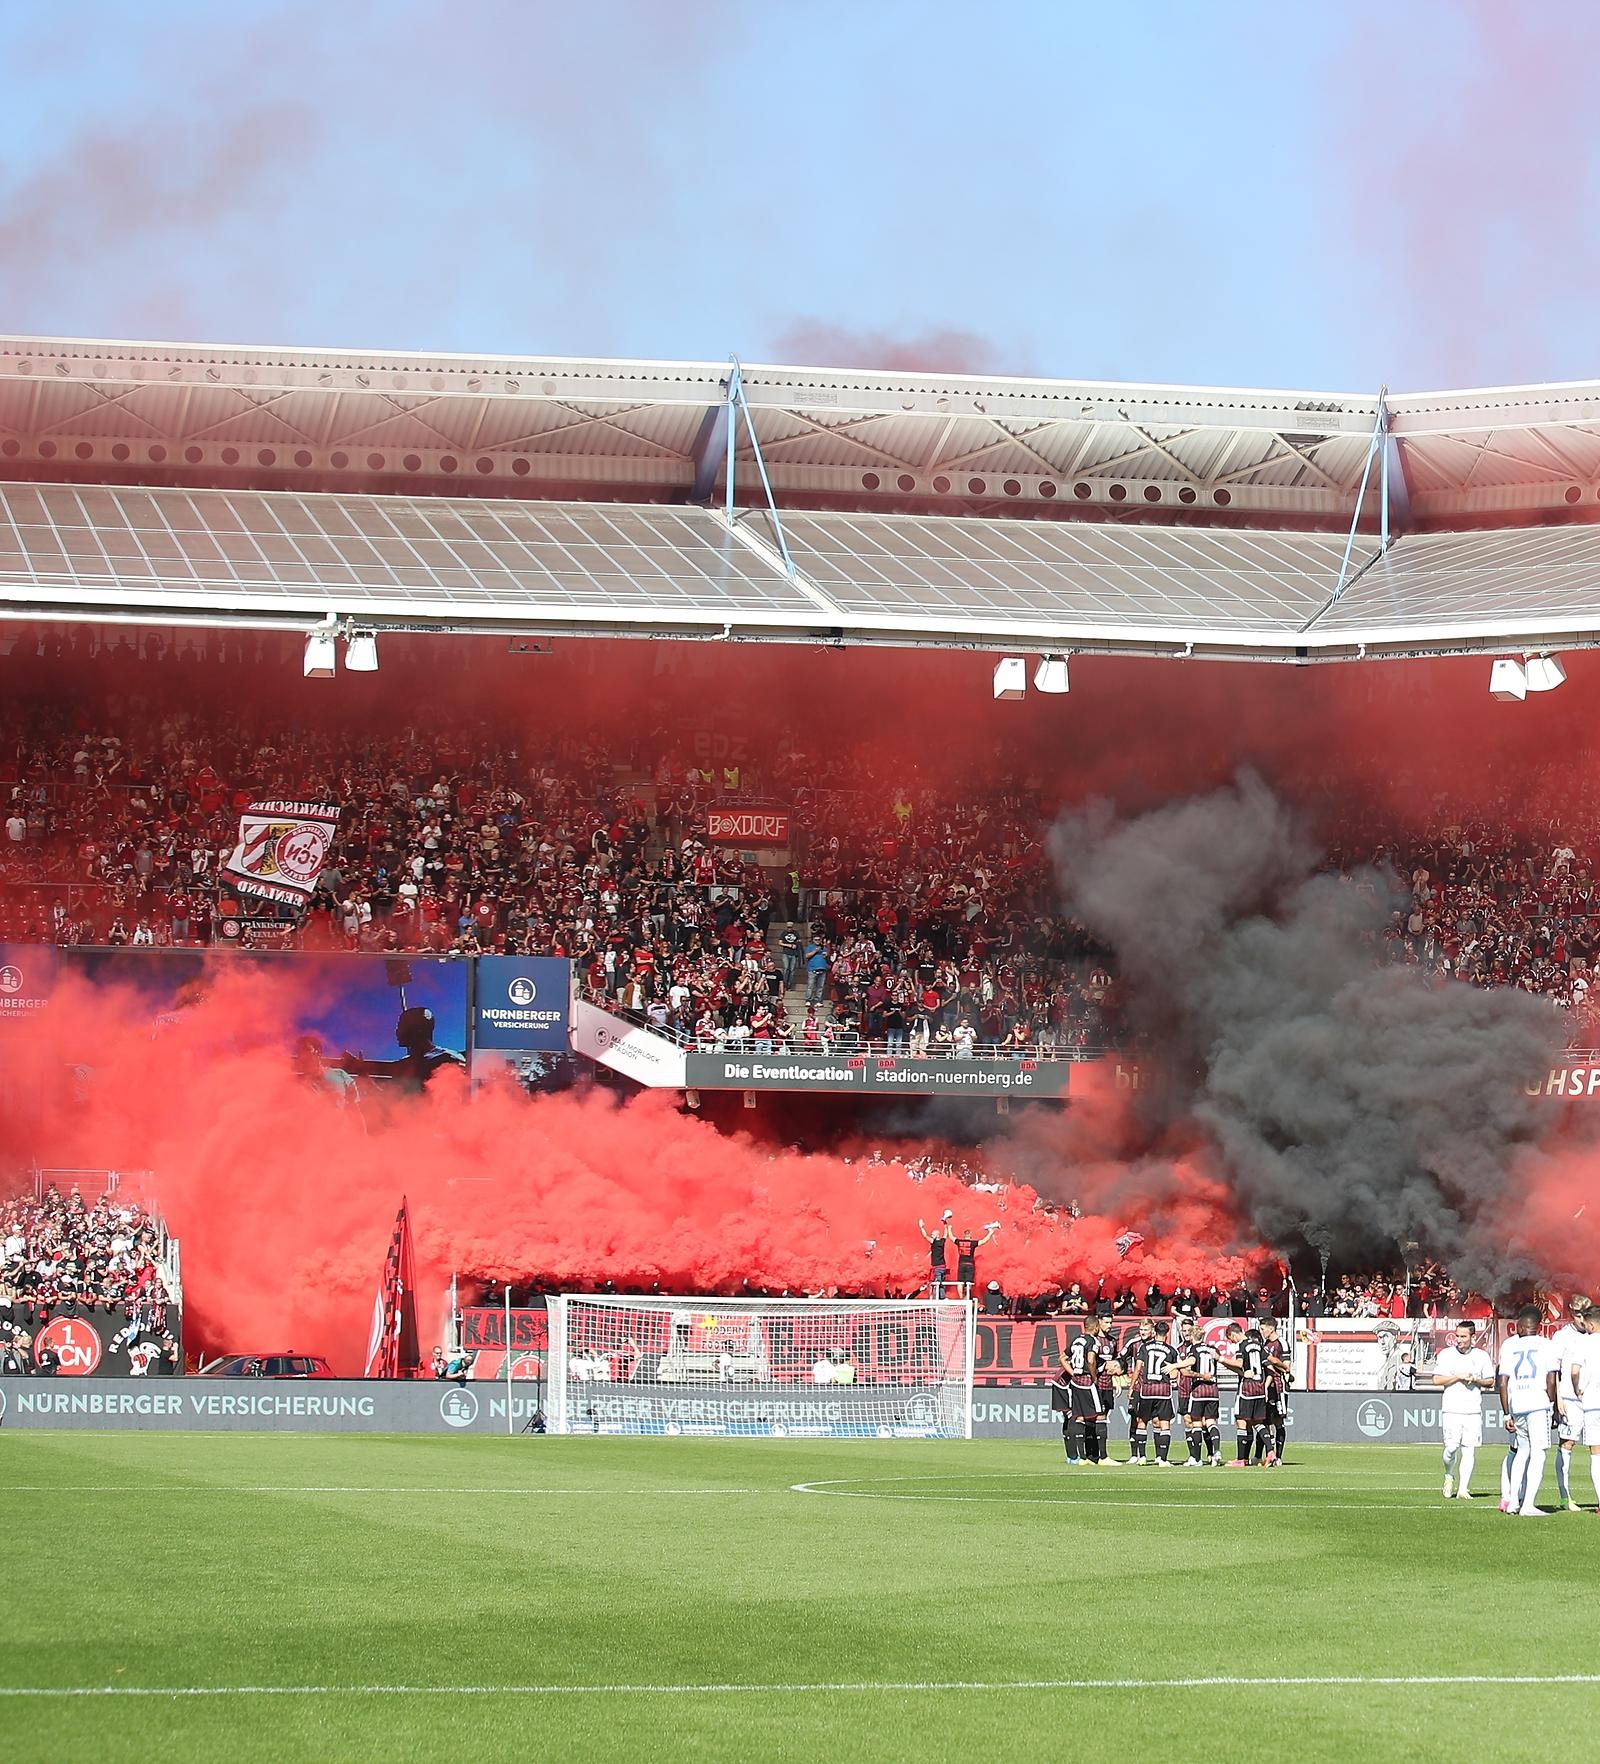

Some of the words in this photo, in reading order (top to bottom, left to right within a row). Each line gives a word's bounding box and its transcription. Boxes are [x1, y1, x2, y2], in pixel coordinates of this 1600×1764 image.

[708, 815, 788, 837] BOXDORF
[482, 1008, 561, 1021] NÜRNBERGER
[493, 1021, 550, 1030] VERSICHERUNG
[724, 1063, 749, 1079] Die
[753, 1064, 854, 1082] Eventlocation
[875, 1068, 1033, 1088] stadion-nuernberg.de
[62, 1325, 75, 1344] 1.
[466, 1314, 532, 1346] KAOS
[1147, 1349, 1167, 1375] 17
[1513, 1349, 1539, 1381] 25
[17, 1392, 182, 1415] NÜRNBERGER
[190, 1394, 375, 1417] VERSICHERUNG
